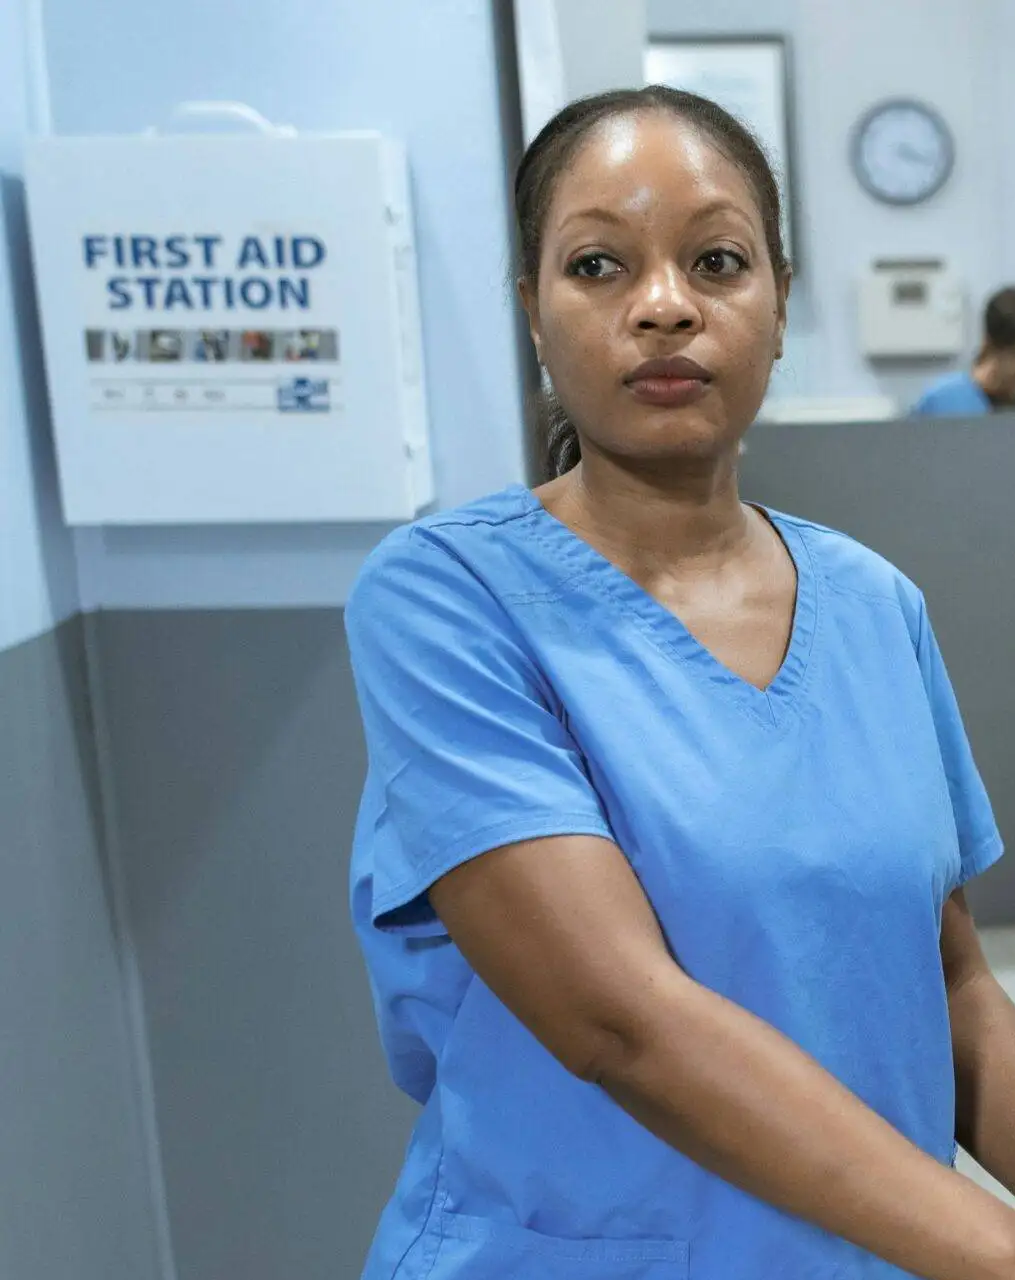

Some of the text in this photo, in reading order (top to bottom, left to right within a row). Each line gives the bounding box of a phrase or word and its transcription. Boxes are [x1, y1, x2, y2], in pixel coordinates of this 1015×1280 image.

[84, 233, 327, 270] FIRST AID
[106, 275, 310, 310] STATION
